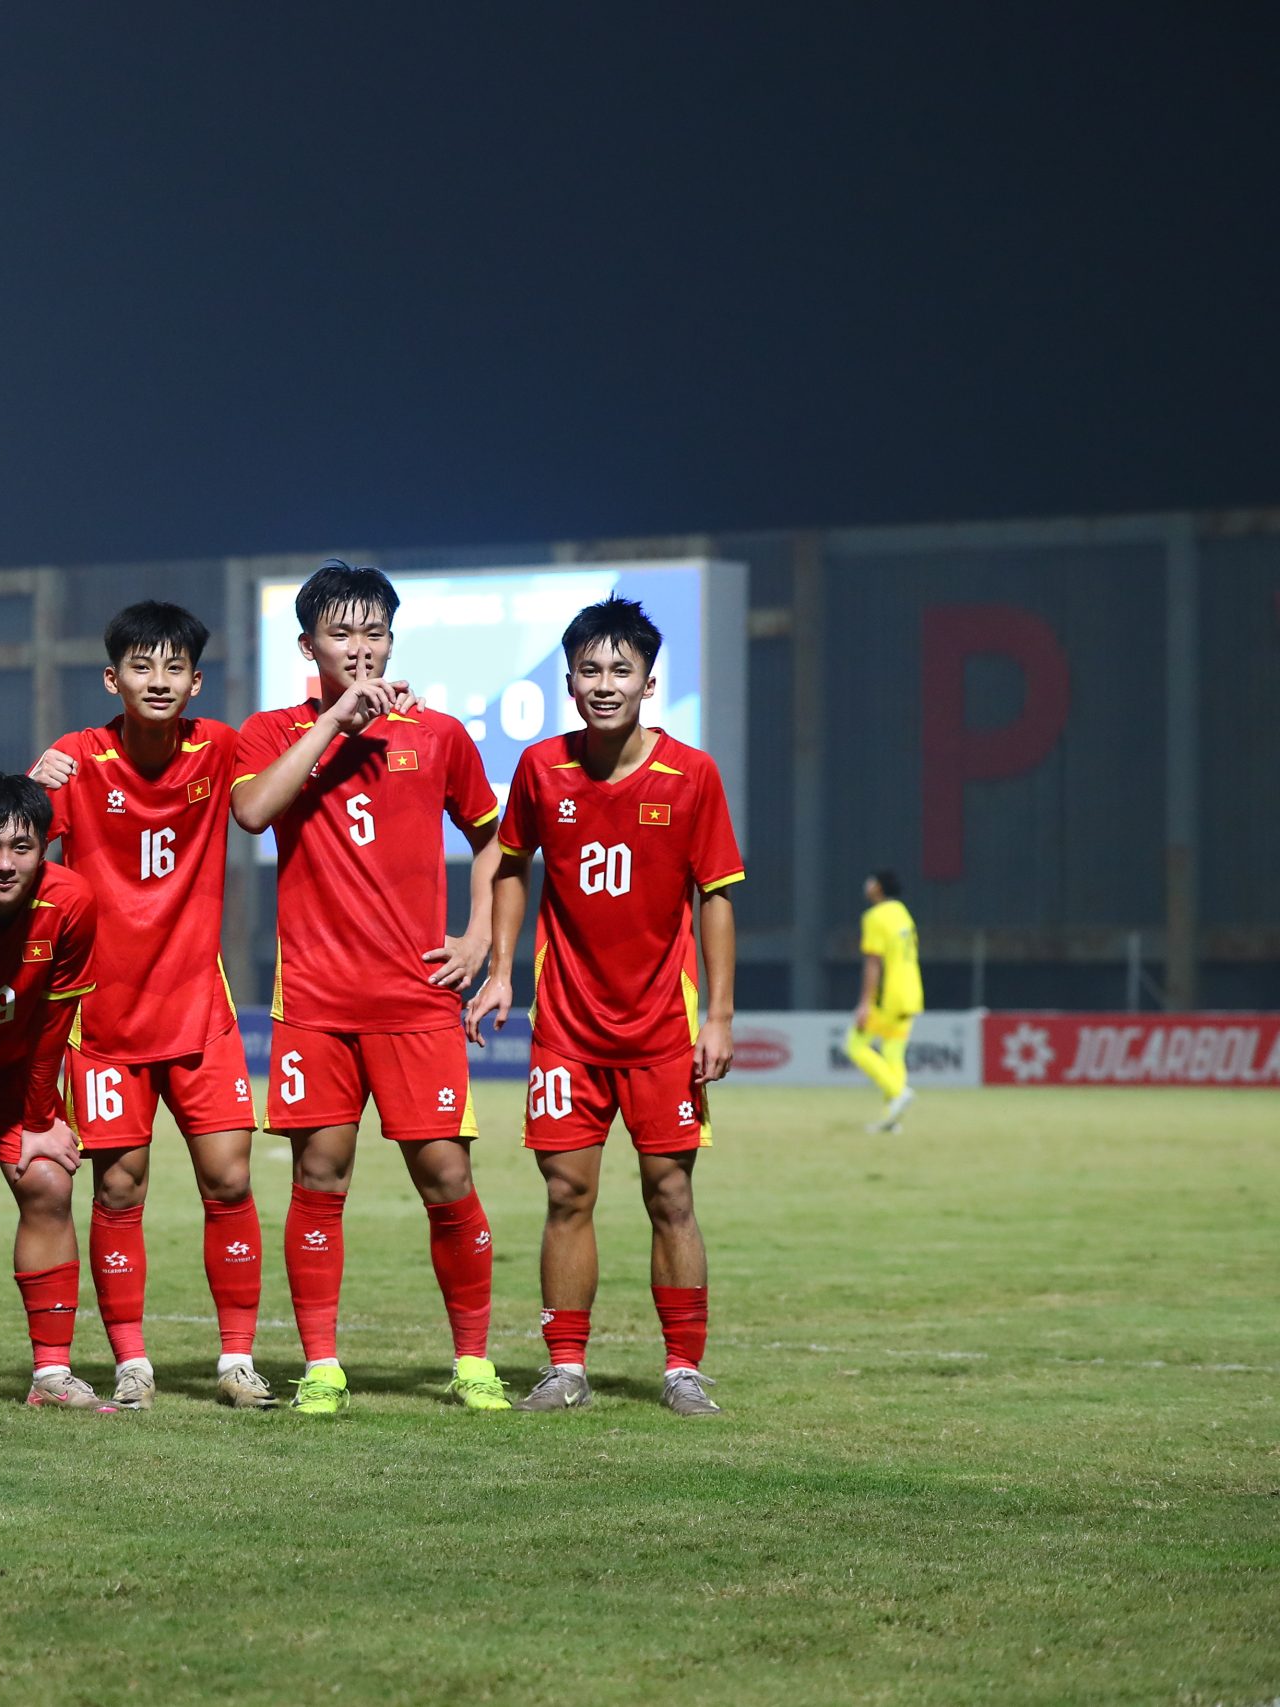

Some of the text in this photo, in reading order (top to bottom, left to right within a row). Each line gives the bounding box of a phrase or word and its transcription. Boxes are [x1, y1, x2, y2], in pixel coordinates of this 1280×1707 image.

[922, 603, 1070, 880] P
[346, 792, 376, 847] 5
[140, 826, 176, 880] 16
[579, 841, 632, 898] 20
[85, 1067, 123, 1123] 16
[280, 1049, 306, 1105] 5
[528, 1065, 573, 1121] 20
